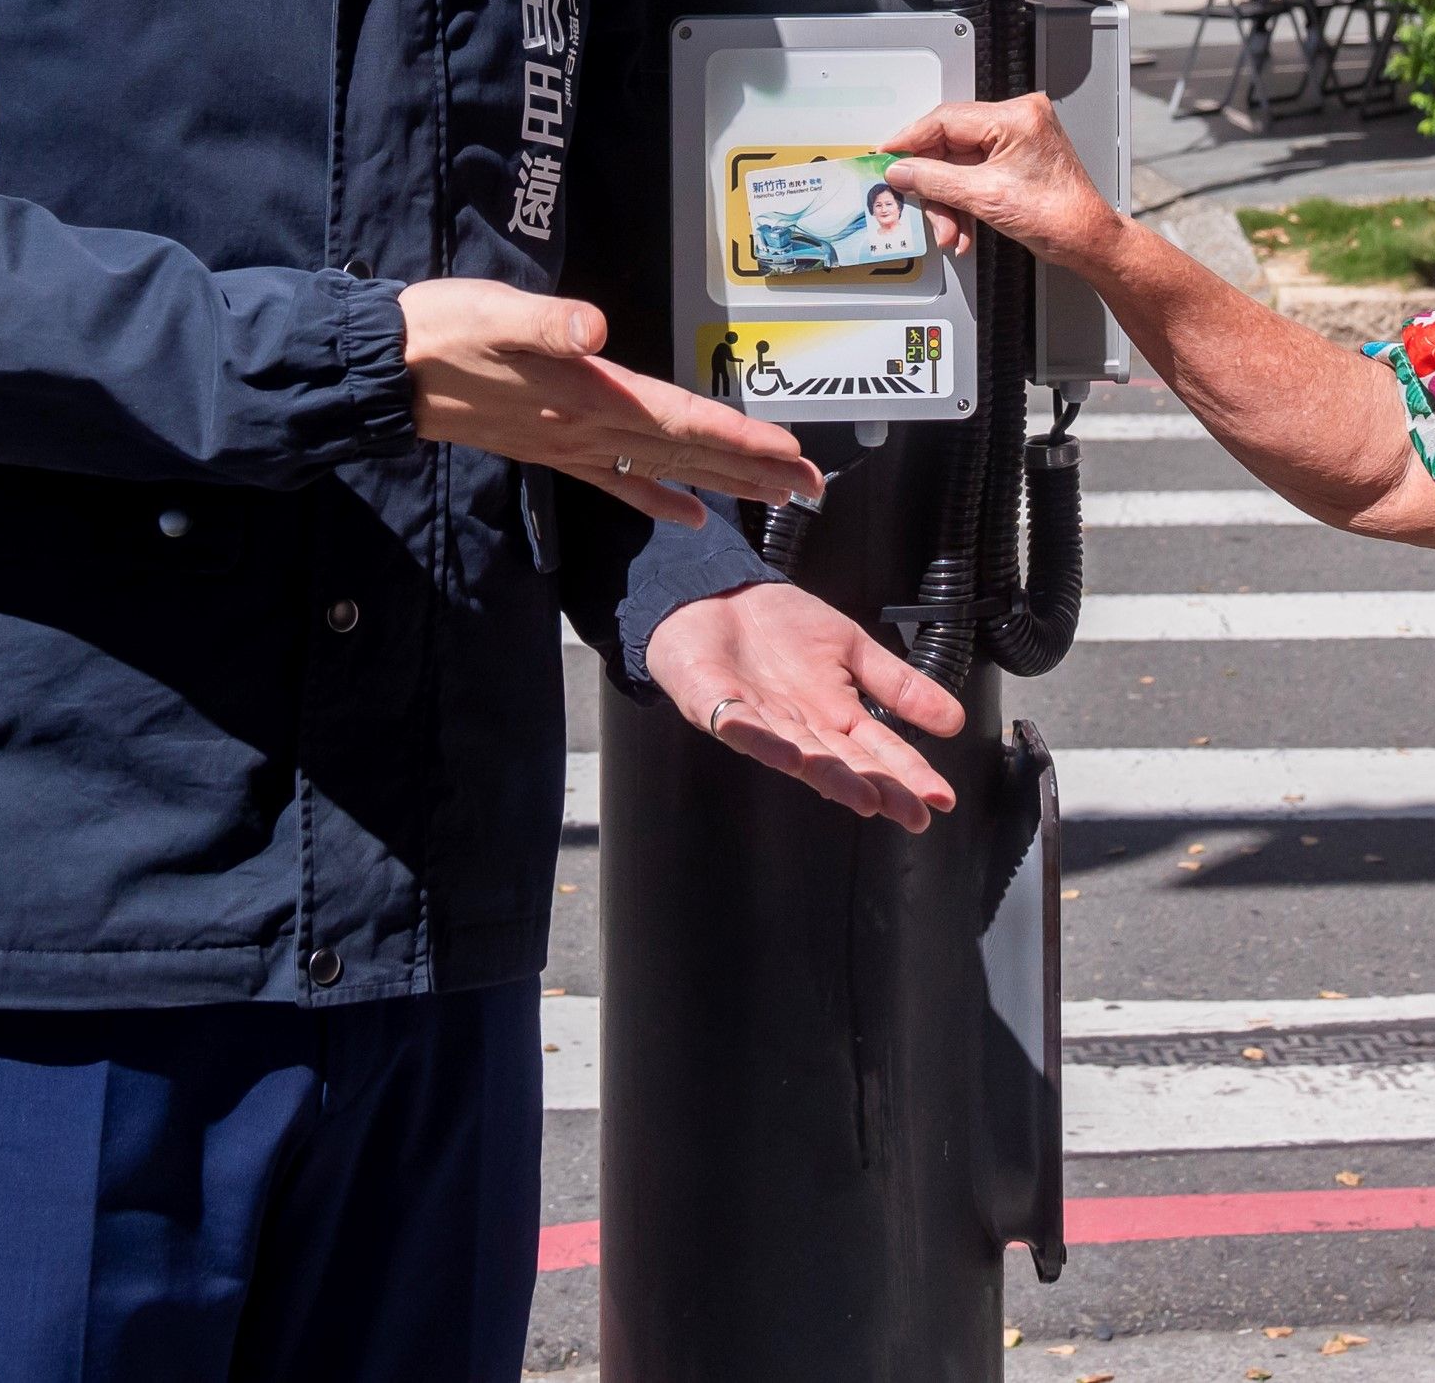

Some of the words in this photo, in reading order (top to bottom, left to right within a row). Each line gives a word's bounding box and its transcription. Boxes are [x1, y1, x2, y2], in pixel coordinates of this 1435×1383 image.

[752, 178, 787, 193] 新竹市
[906, 346, 924, 362] 27
